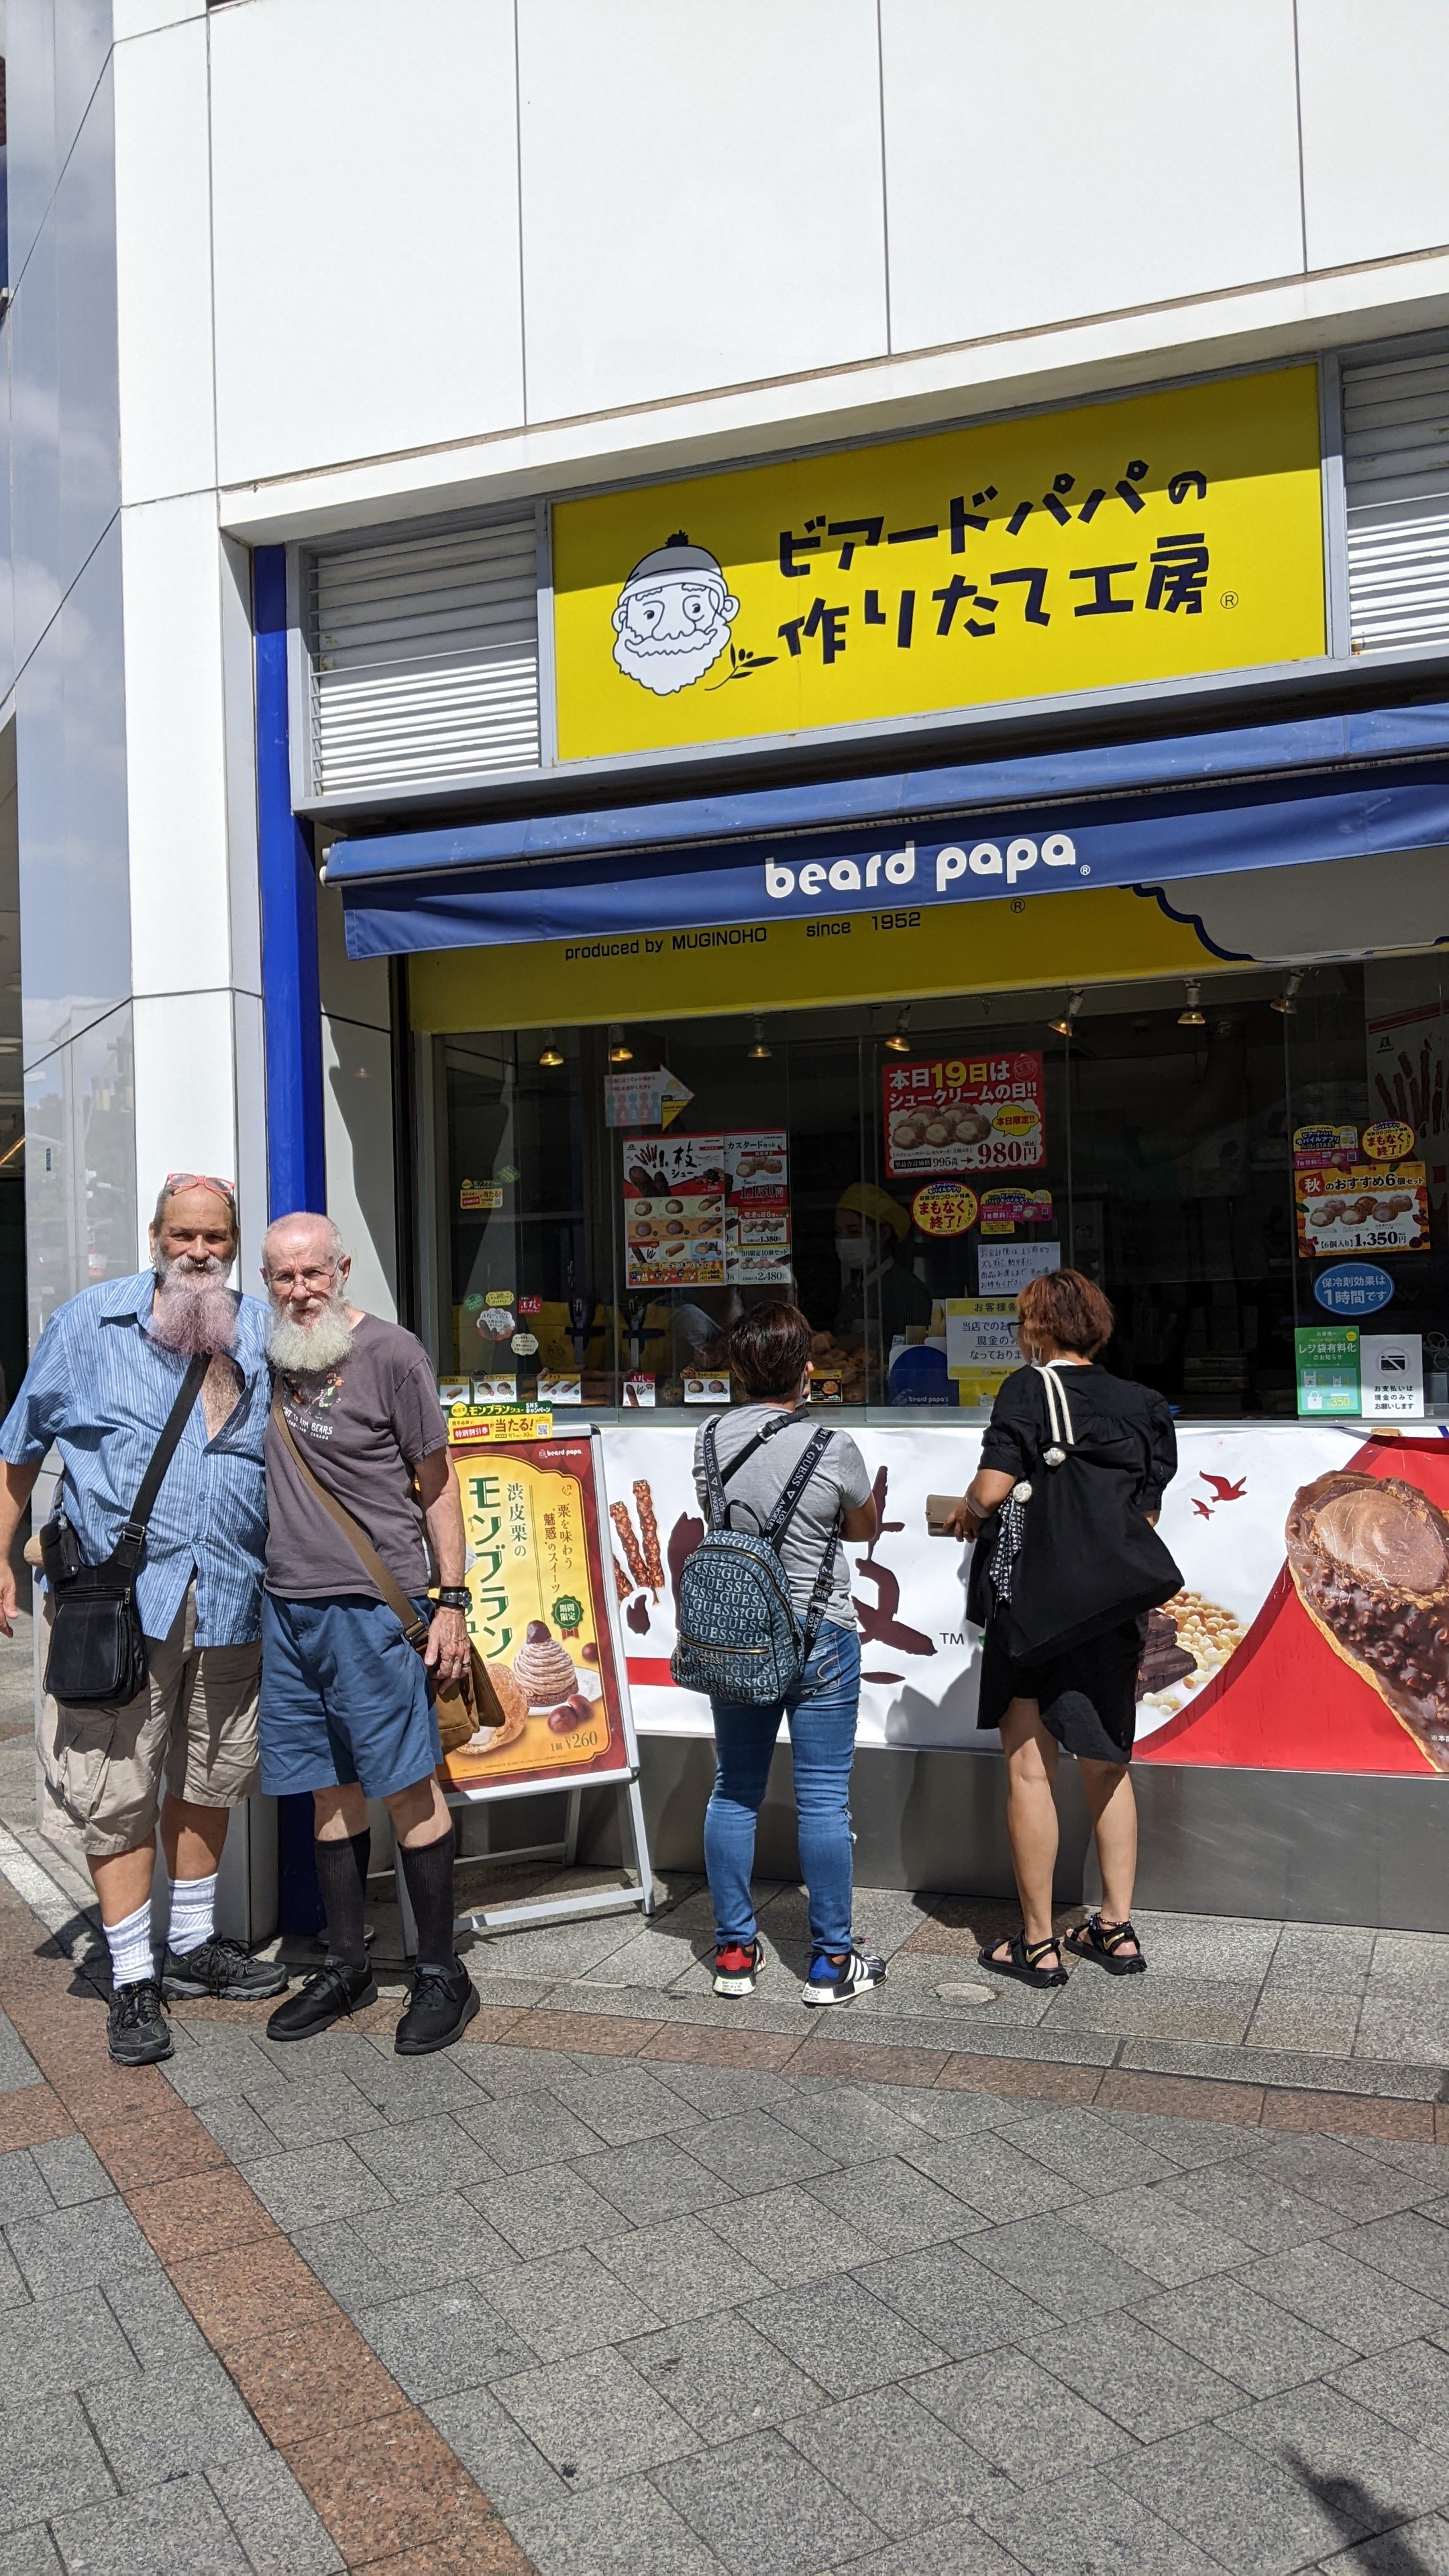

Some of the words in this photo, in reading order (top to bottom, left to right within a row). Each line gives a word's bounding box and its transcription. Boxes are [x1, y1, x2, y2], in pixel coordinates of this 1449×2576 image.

[779, 460, 1207, 578] ビアードパパの
[777, 533, 1209, 665] 作りたて工房
[764, 840, 914, 898] beard
[936, 834, 1076, 892] papa
[565, 940, 639, 961] produced
[645, 938, 663, 954] by
[672, 927, 767, 951] MUGINOHO
[806, 920, 851, 937] since
[870, 912, 921, 931] 1952
[889, 1061, 1011, 1092] 本日19日は
[890, 1081, 1037, 1108] シュークリームの日!!
[1367, 1134, 1404, 1147] まもなく
[1377, 1144, 1402, 1157] 終了!
[919, 1200, 964, 1215] まもなく
[930, 1216, 962, 1229] 終了!
[1322, 1275, 1386, 1288] 保冷剤効果は
[1324, 1289, 1387, 1305] 1時間です
[1299, 1343, 1356, 1353] レジ袋有料化
[311, 1422, 333, 1436] BEARS
[496, 1418, 534, 1432] 当たる!
[310, 1431, 329, 1440] CANADA
[704, 1438, 716, 1474] GUESS
[792, 1452, 815, 1487] GUESS
[710, 1490, 722, 1524] ANGELES
[718, 1497, 726, 1512] LOS
[507, 1483, 528, 1558] 渋皮栗の
[766, 1498, 787, 1532] ANGELES
[775, 1510, 788, 1525] LOS
[557, 1503, 574, 1570] 栗を味わう
[469, 1476, 513, 1659] モンブラン
[559, 1605, 575, 1613] 期間
[561, 1612, 577, 1622] 限定
[939, 1633, 965, 1645] TM
[566, 1731, 598, 1750] ¥260
